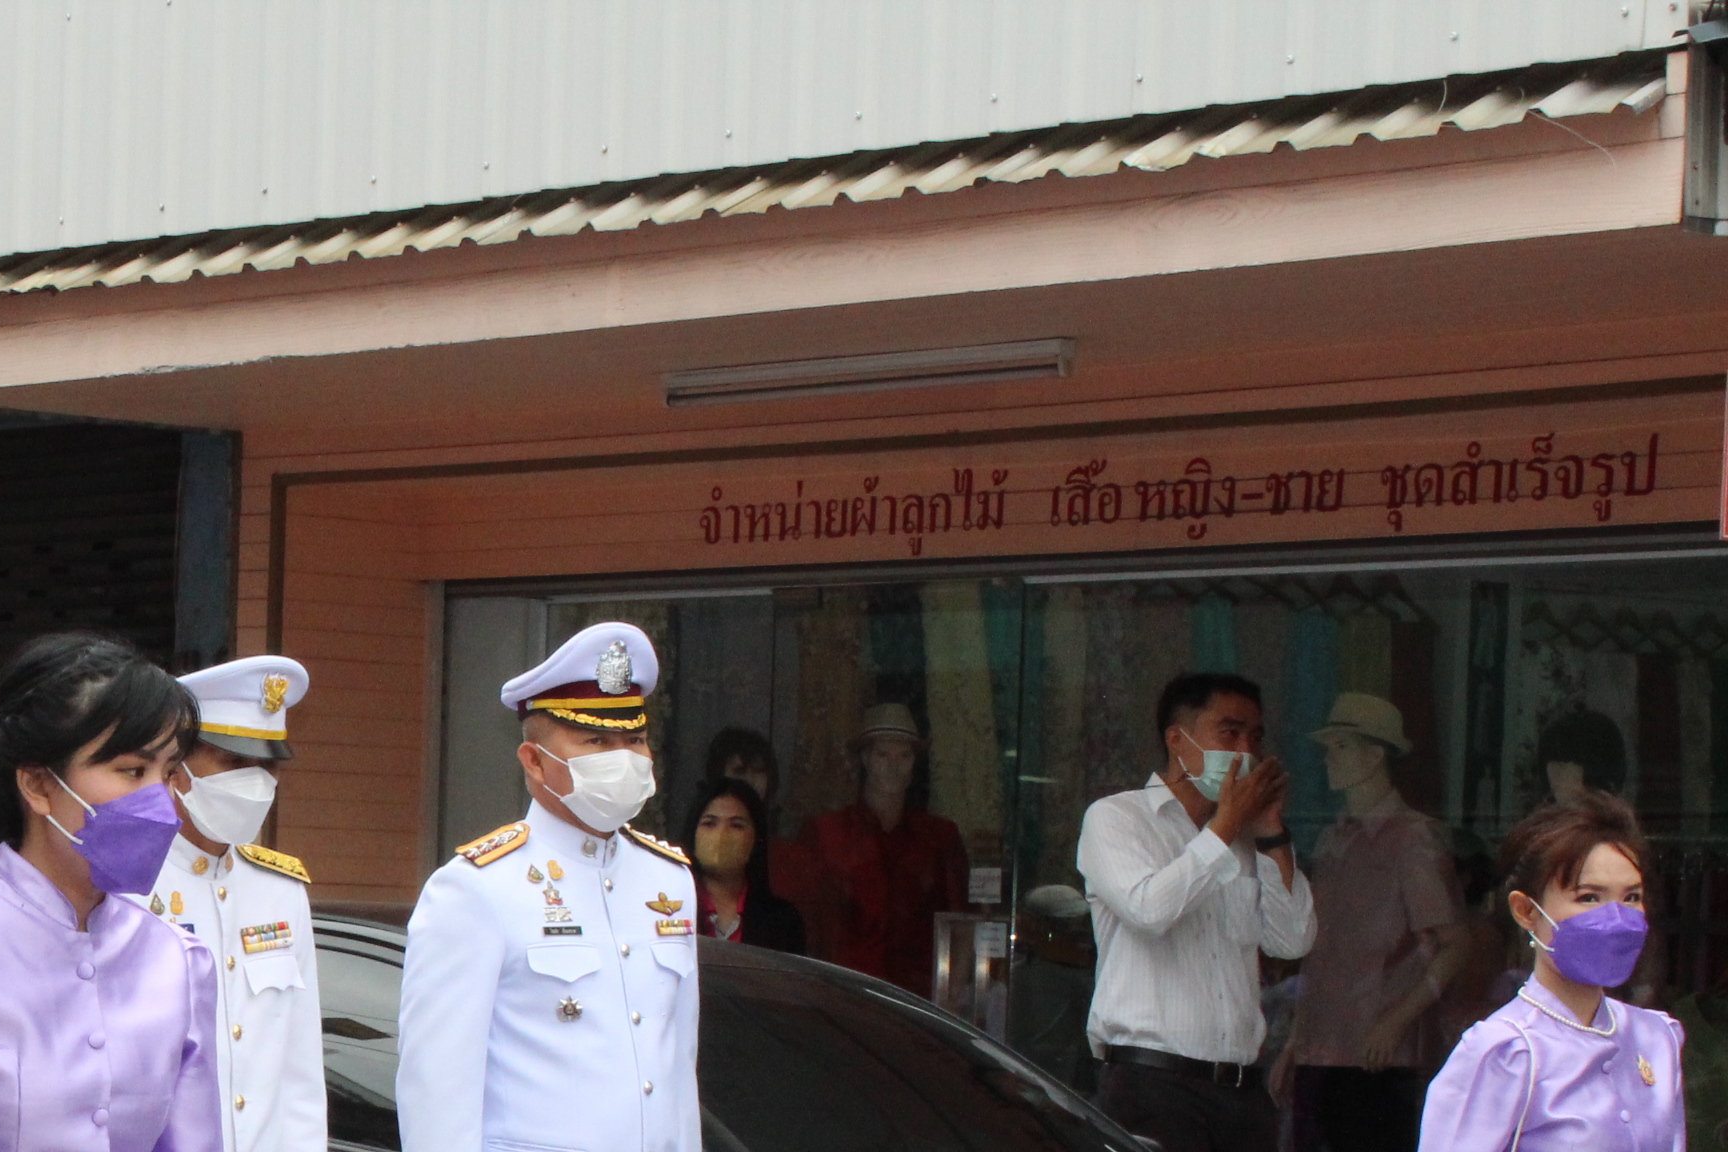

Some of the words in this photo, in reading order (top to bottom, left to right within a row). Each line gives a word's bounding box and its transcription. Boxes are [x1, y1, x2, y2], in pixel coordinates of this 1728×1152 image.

[699, 468, 1009, 556] จำหน่ายผ้าลูกไม้
[1380, 433, 1660, 532] ชุดสำเร็จรูป
